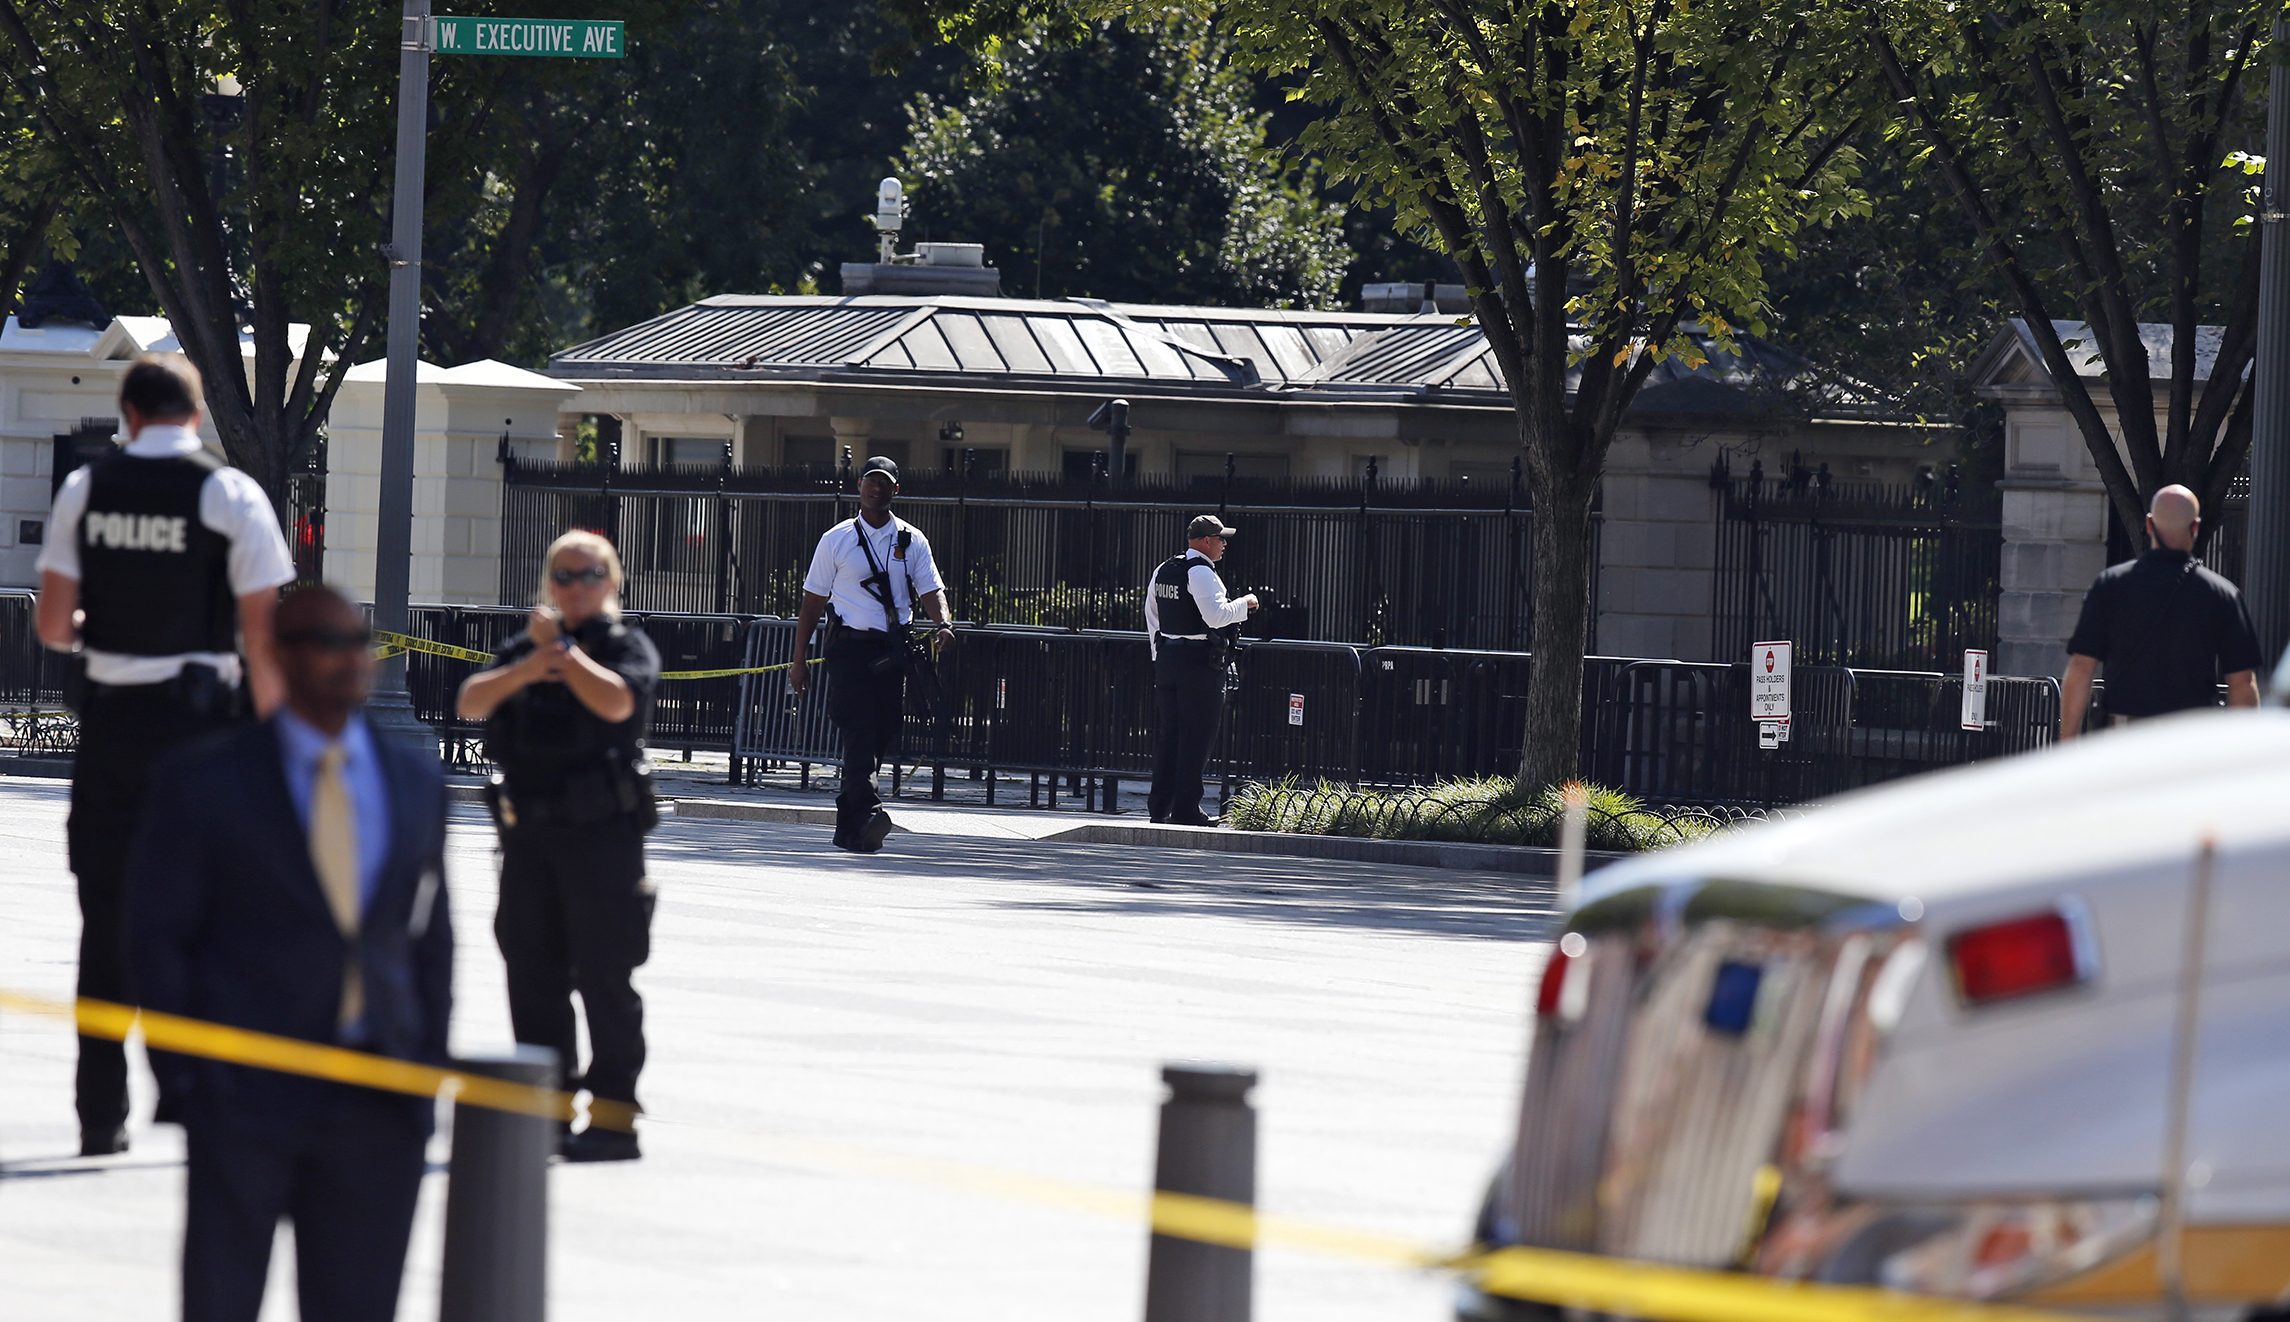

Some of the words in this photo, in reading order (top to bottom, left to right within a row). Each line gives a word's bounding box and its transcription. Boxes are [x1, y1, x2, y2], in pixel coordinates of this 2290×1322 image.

[440, 22, 461, 49] W.
[476, 23, 574, 52] EXECUTIVE
[582, 26, 617, 53] AVE
[86, 510, 188, 553] POLICE
[1155, 583, 1180, 600] POLICE
[404, 637, 418, 648] CROSS
[440, 645, 454, 656] POLICE
[464, 650, 478, 661] CROSS
